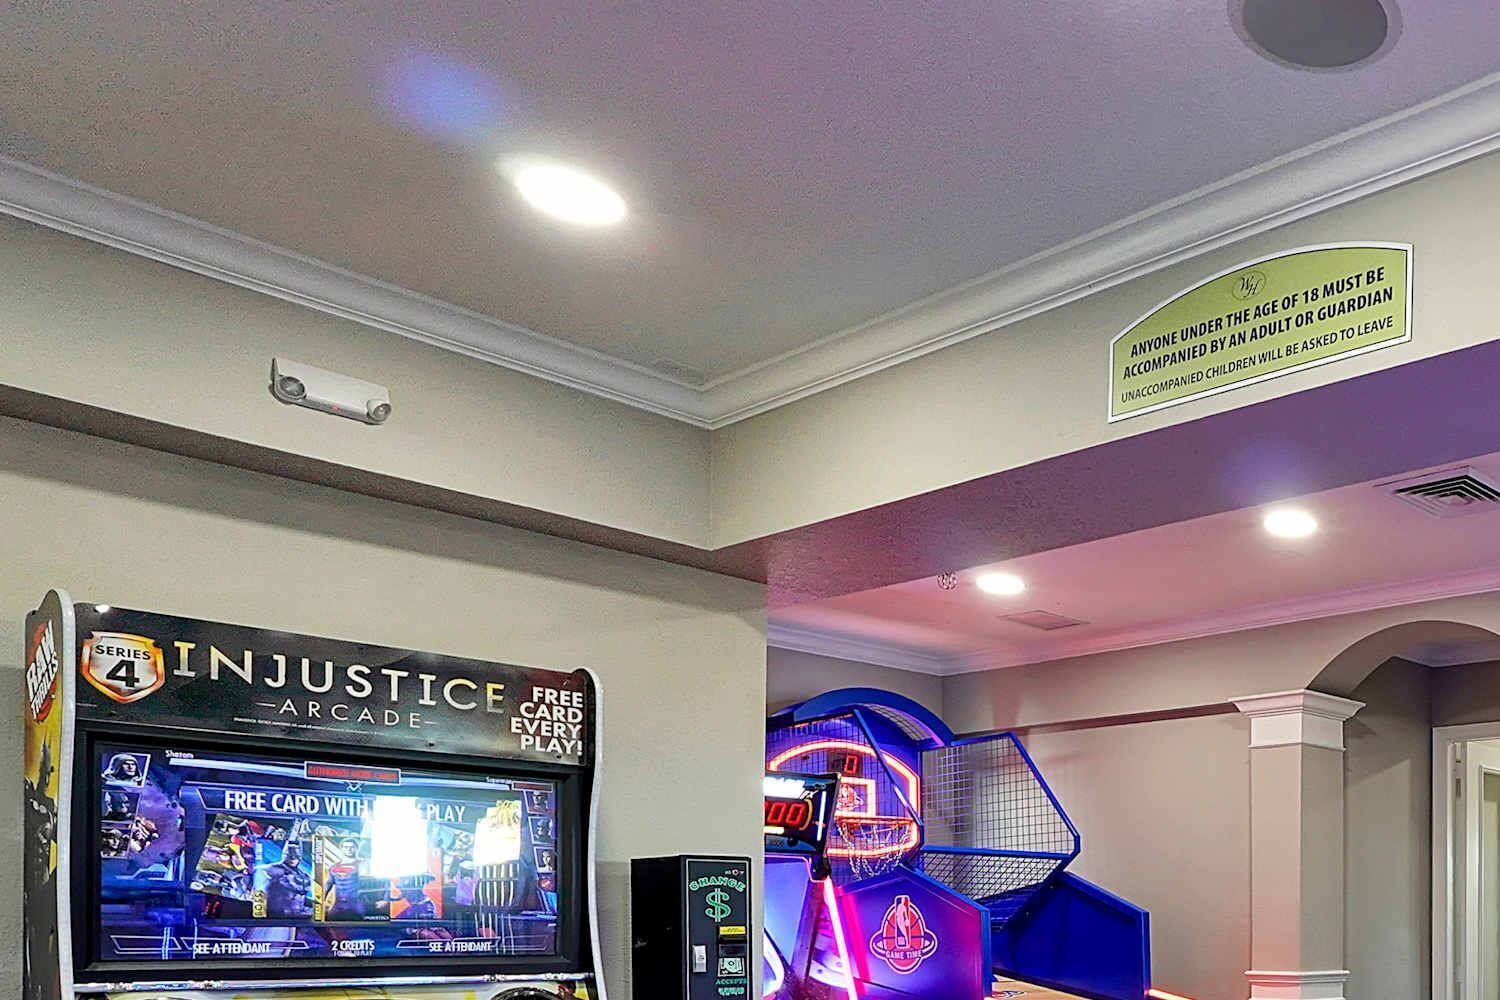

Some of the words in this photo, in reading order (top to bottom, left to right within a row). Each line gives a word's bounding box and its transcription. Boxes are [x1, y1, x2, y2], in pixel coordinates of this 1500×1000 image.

[1130, 331, 1178, 358] ANYONE
[1180, 318, 1223, 343] UNDER
[1226, 310, 1250, 329] THE
[1253, 303, 1278, 321] AGE
[1281, 294, 1299, 311] OF
[1302, 287, 1319, 305] 18
[1322, 274, 1362, 299] MUST
[1366, 266, 1385, 285] BE
[1123, 346, 1207, 380] ACCOMPANIED
[1210, 336, 1227, 353] BY
[1228, 330, 1246, 349] AN
[1249, 317, 1292, 342] ADULT
[1295, 310, 1314, 328] OR
[1317, 286, 1393, 321] GUARDIAN
[1121, 371, 1204, 403] UNACCOMPANIED
[1205, 355, 1256, 379] CHILDREN
[1258, 348, 1283, 365] WILL
[1285, 344, 1299, 357] BE
[1301, 332, 1337, 353] ASKED
[1339, 327, 1355, 342] TO
[1357, 315, 1393, 336] LEAVE
[95, 644, 151, 661] SERIES
[106, 660, 140, 688] 4
[173, 640, 505, 714] INJUSTICE
[532, 686, 583, 708] FREE
[279, 699, 421, 728] ARCADE
[519, 702, 583, 723] CARD
[510, 717, 582, 740] EVERY
[520, 734, 583, 756] PLAY!
[225, 790, 267, 811] FREE
[271, 793, 320, 814] CARD
[325, 797, 368, 817] WITH
[427, 804, 466, 823] PLAY
[765, 801, 807, 825] 00
[689, 876, 746, 893] CHANGE
[193, 943, 214, 955] SEE
[214, 942, 272, 954] ATTENDANT
[331, 941, 340, 950] 2
[341, 940, 375, 951] CREDITS
[429, 941, 442, 952] SEE
[444, 941, 492, 952] ATTENDANT
[885, 950, 905, 960] GAME
[906, 950, 923, 959] TIME
